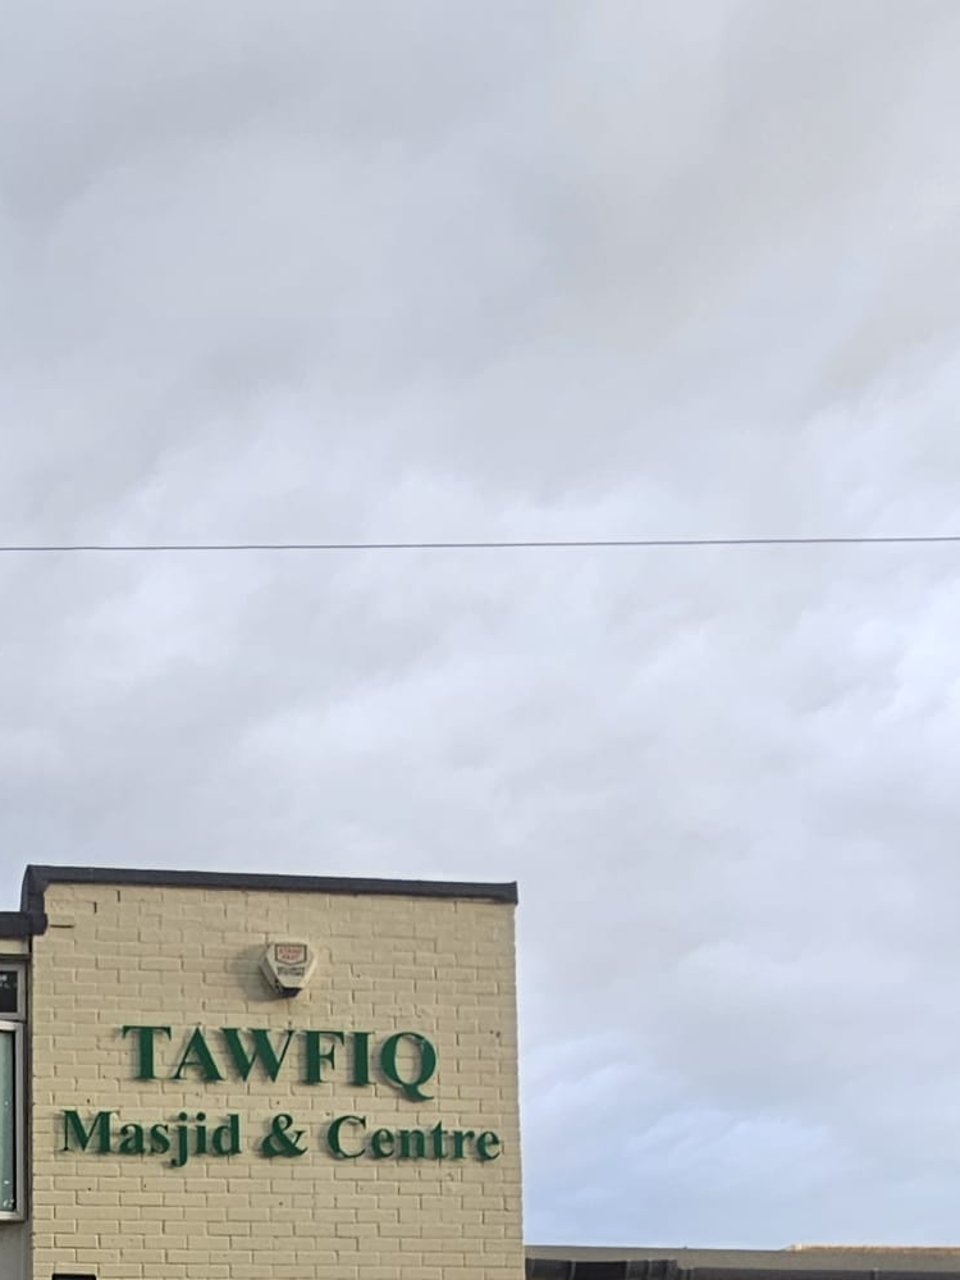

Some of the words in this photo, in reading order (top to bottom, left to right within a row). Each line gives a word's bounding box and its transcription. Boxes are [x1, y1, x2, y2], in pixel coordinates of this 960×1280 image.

[122, 1025, 438, 1101] TAWFIQ
[63, 1109, 242, 1167] Masjid
[260, 1113, 308, 1158] &
[327, 1114, 501, 1160] Centre
